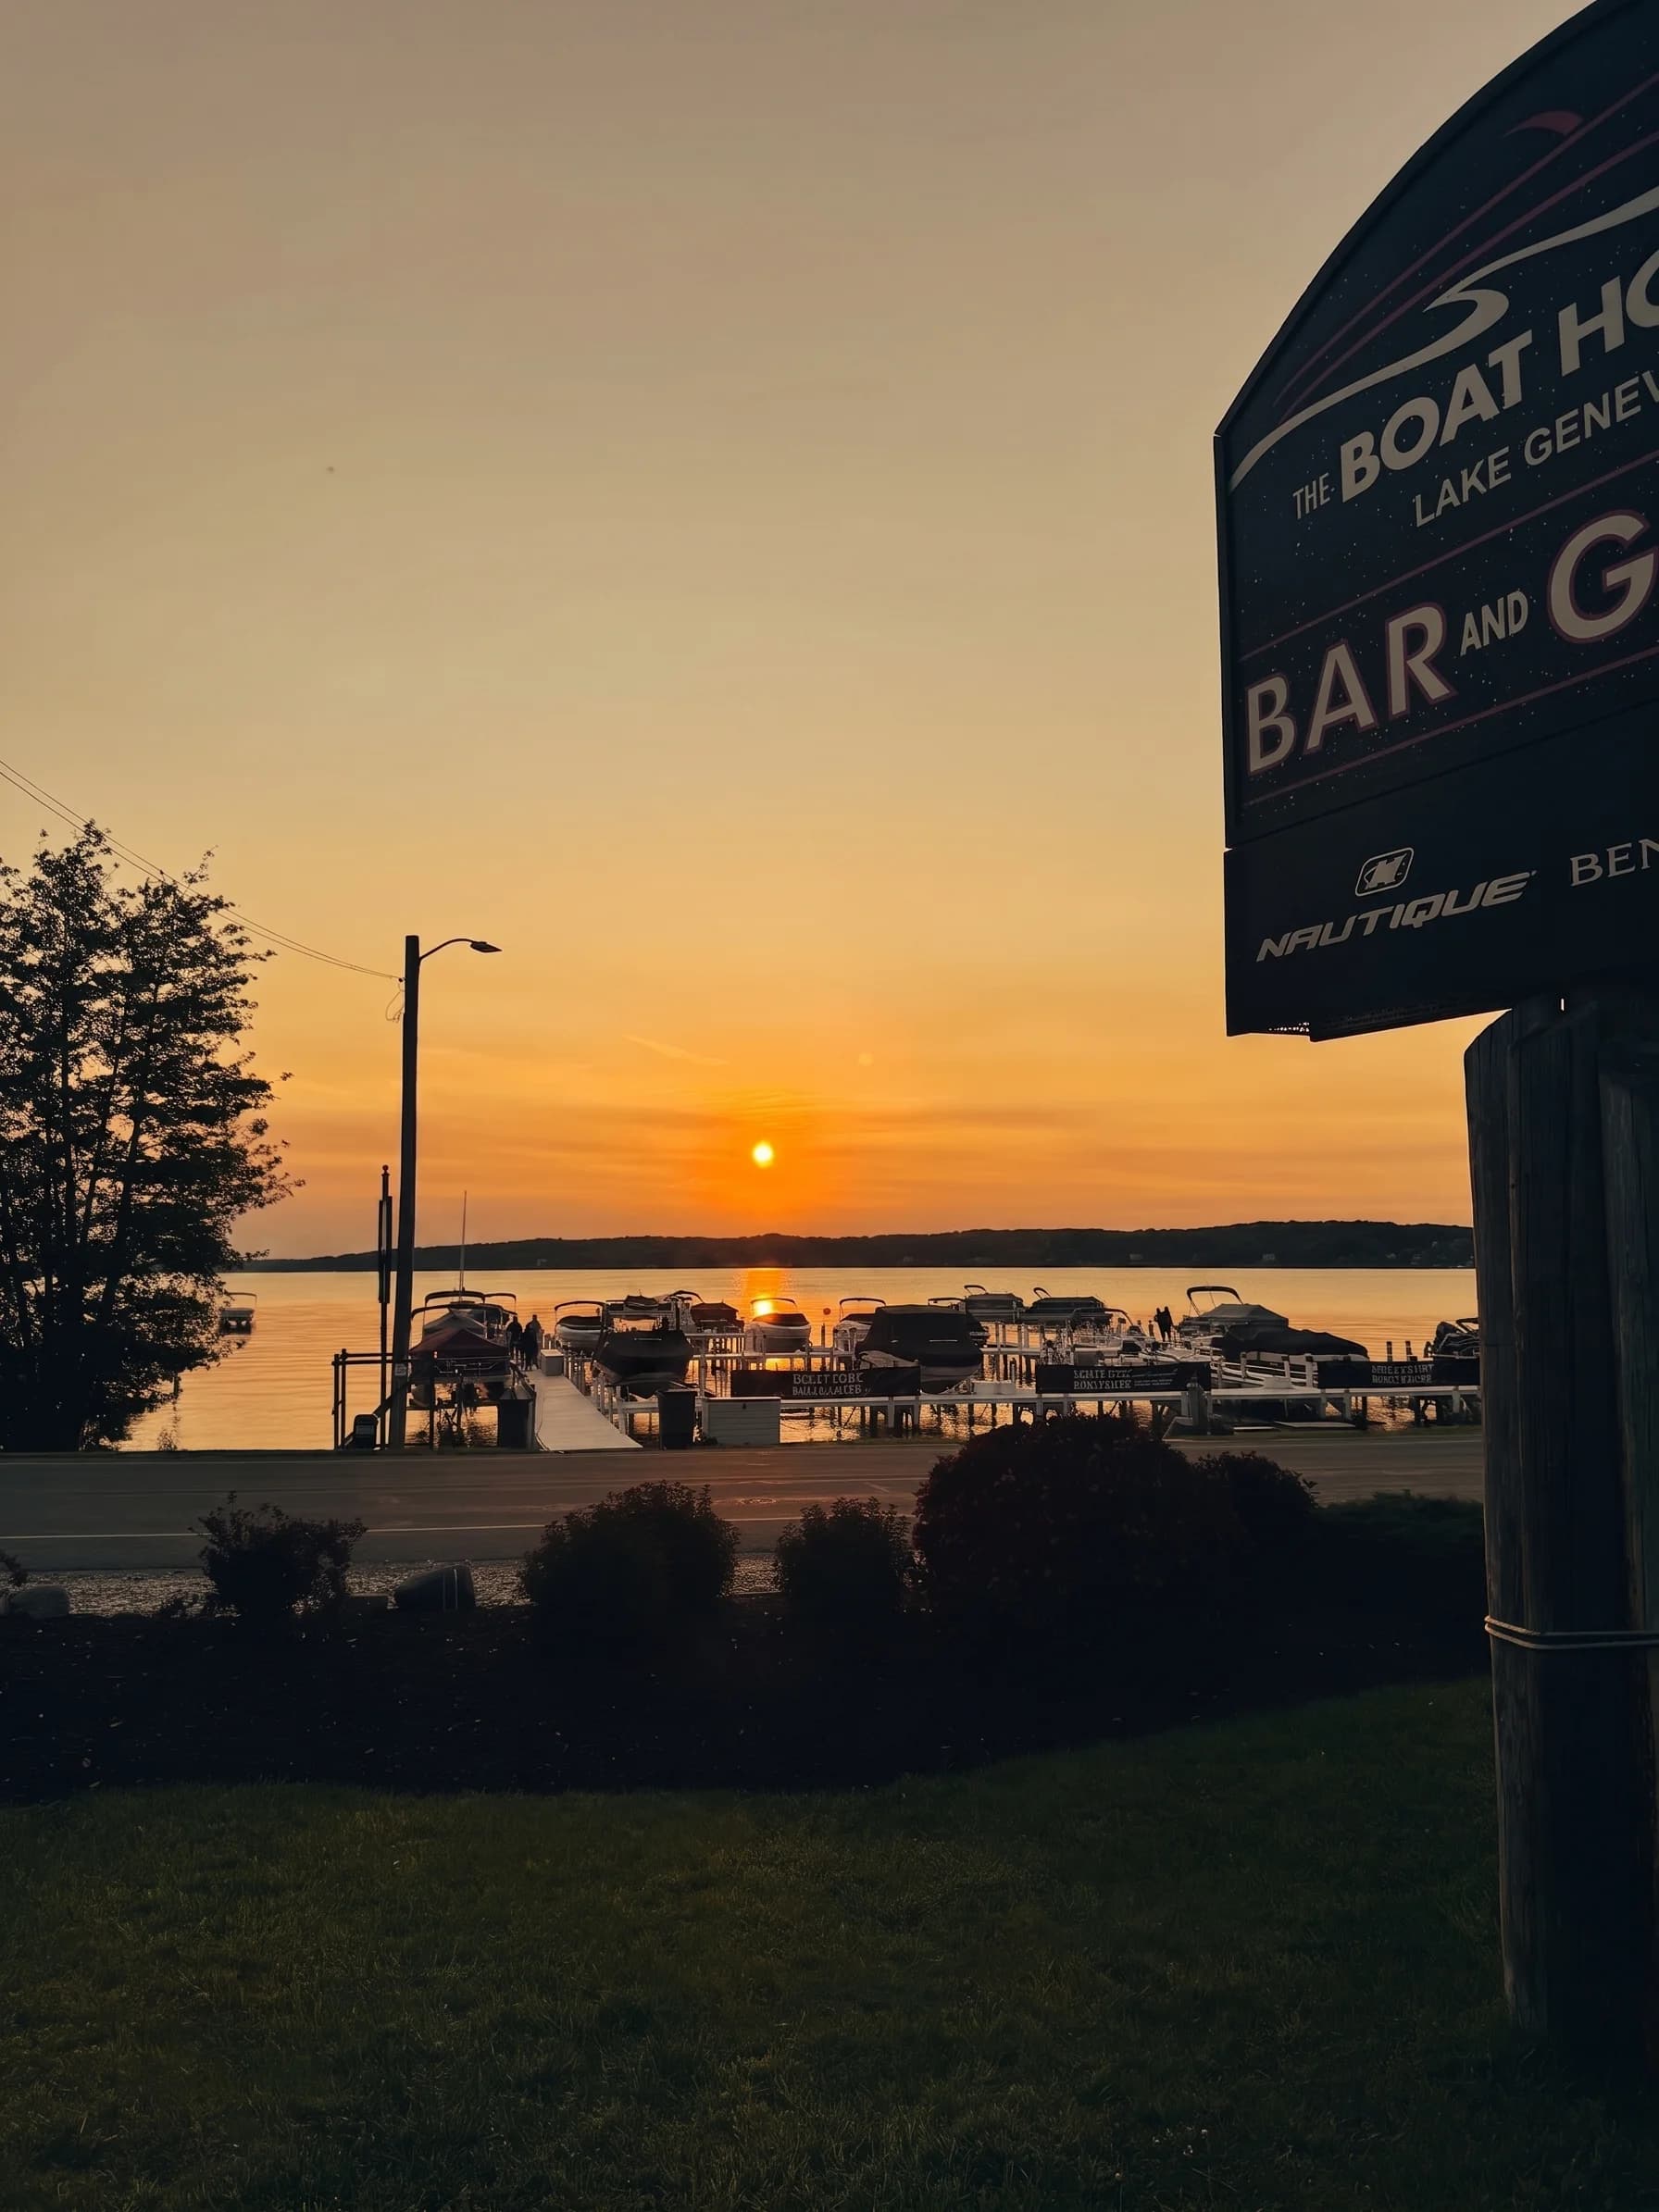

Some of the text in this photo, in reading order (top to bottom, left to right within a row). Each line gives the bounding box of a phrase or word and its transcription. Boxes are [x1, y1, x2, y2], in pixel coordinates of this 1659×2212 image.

[1292, 473, 1330, 519] THE
[1341, 329, 1533, 503] BOAT
[1415, 445, 1512, 528] LAKE
[1245, 508, 1659, 777] BAR AND G
[1569, 837, 1659, 888] BEN
[1255, 871, 1531, 963] NAUTIQUE
